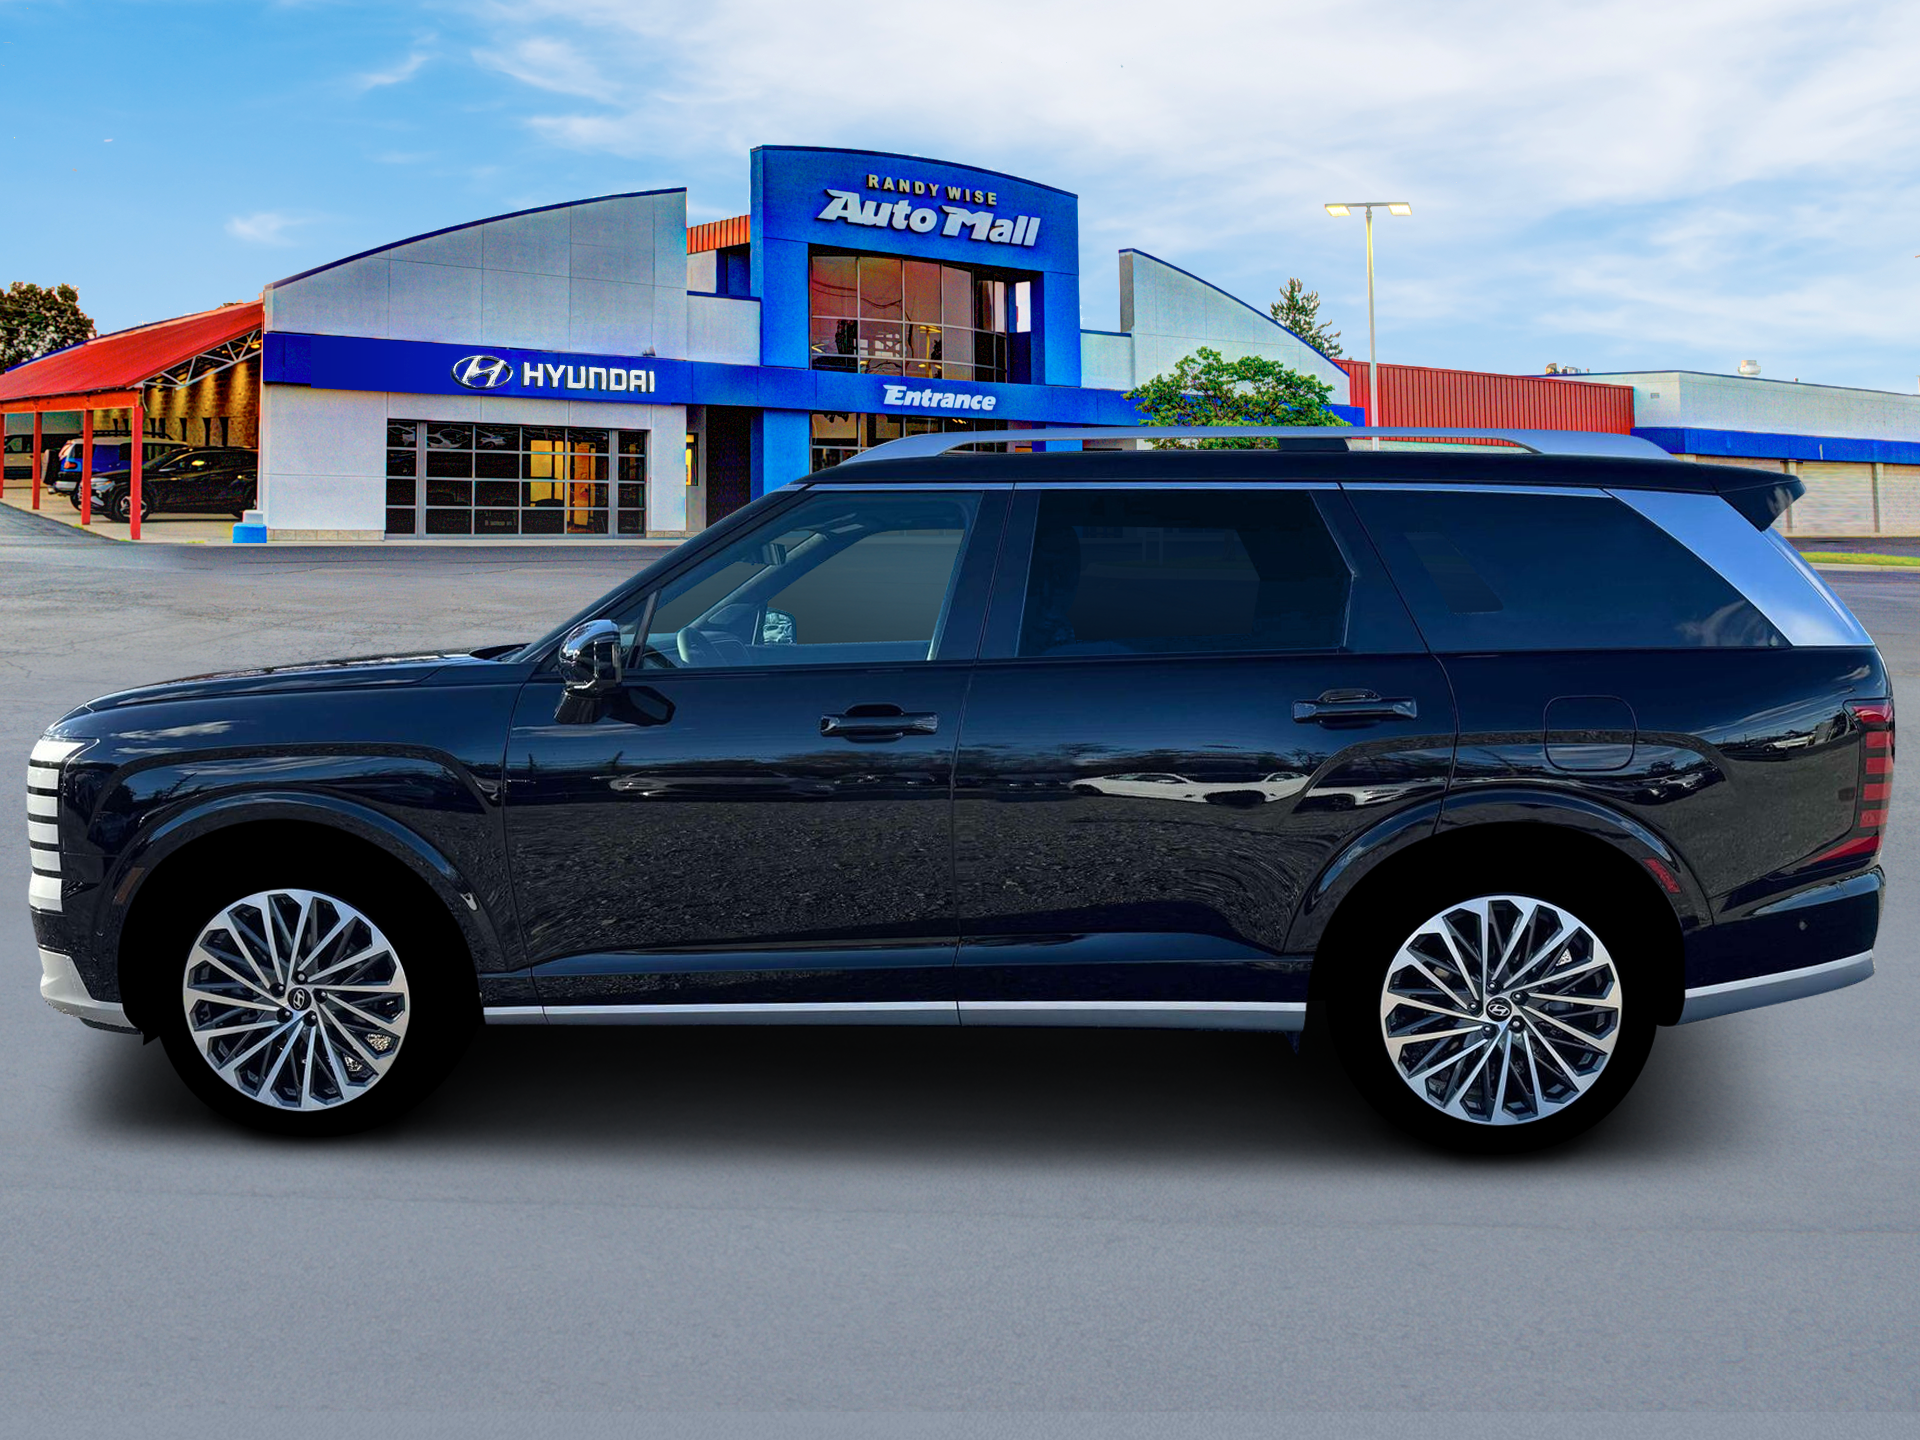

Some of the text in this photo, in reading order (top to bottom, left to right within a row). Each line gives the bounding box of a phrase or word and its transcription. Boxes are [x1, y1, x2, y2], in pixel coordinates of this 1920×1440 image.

[867, 174, 997, 206] RANDY WISE
[818, 189, 1041, 247] Auto Mall
[522, 362, 655, 393] HYUNDAI
[883, 384, 997, 411] Entrance
